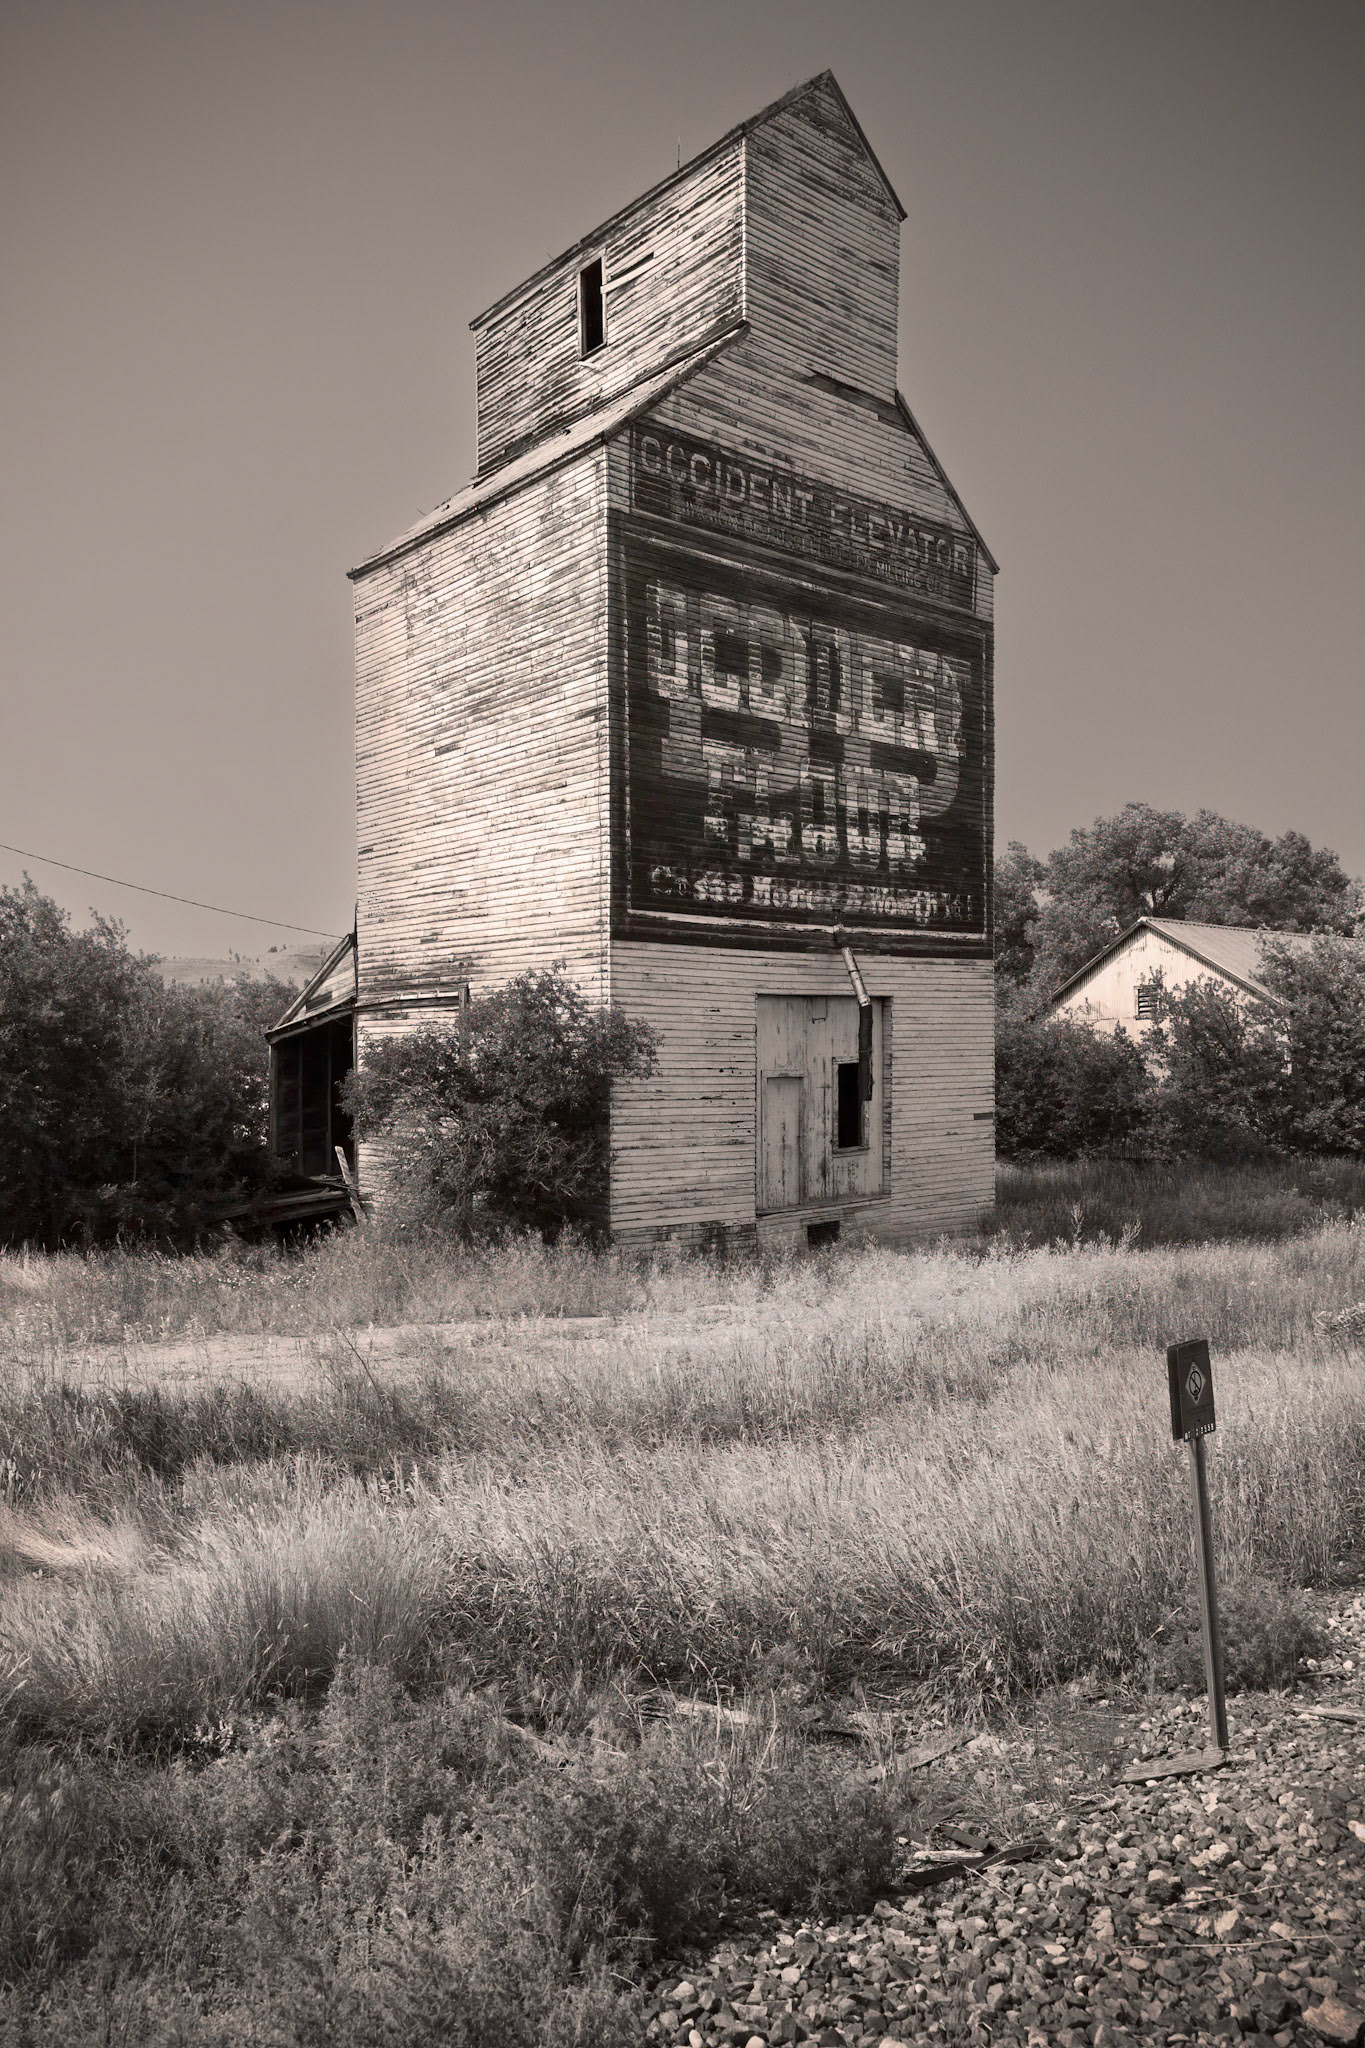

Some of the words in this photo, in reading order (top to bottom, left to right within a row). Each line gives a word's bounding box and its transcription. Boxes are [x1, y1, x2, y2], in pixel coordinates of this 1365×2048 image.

[639, 435, 814, 525] OCCIDENT
[830, 502, 974, 577] ELEVATOR
[875, 558, 922, 588] MILLING
